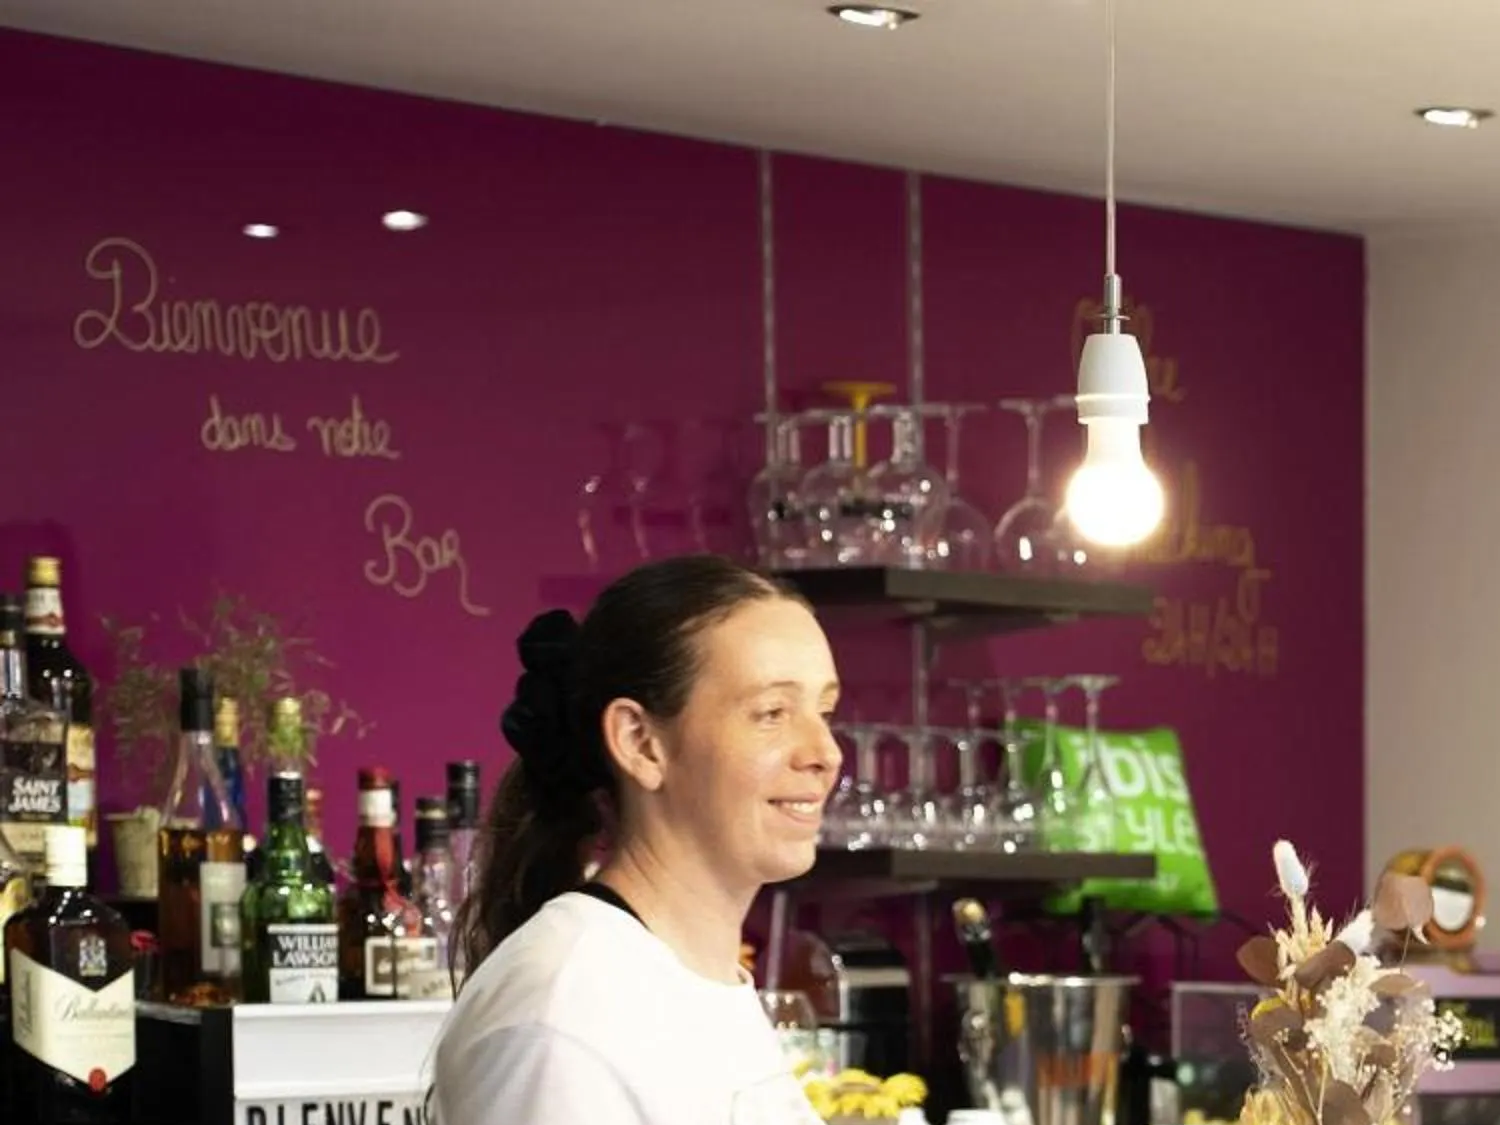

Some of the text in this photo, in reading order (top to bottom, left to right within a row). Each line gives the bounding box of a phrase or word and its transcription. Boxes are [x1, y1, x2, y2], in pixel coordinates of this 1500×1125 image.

[74, 237, 399, 362] Bienvenue
[202, 394, 399, 458] dans notre
